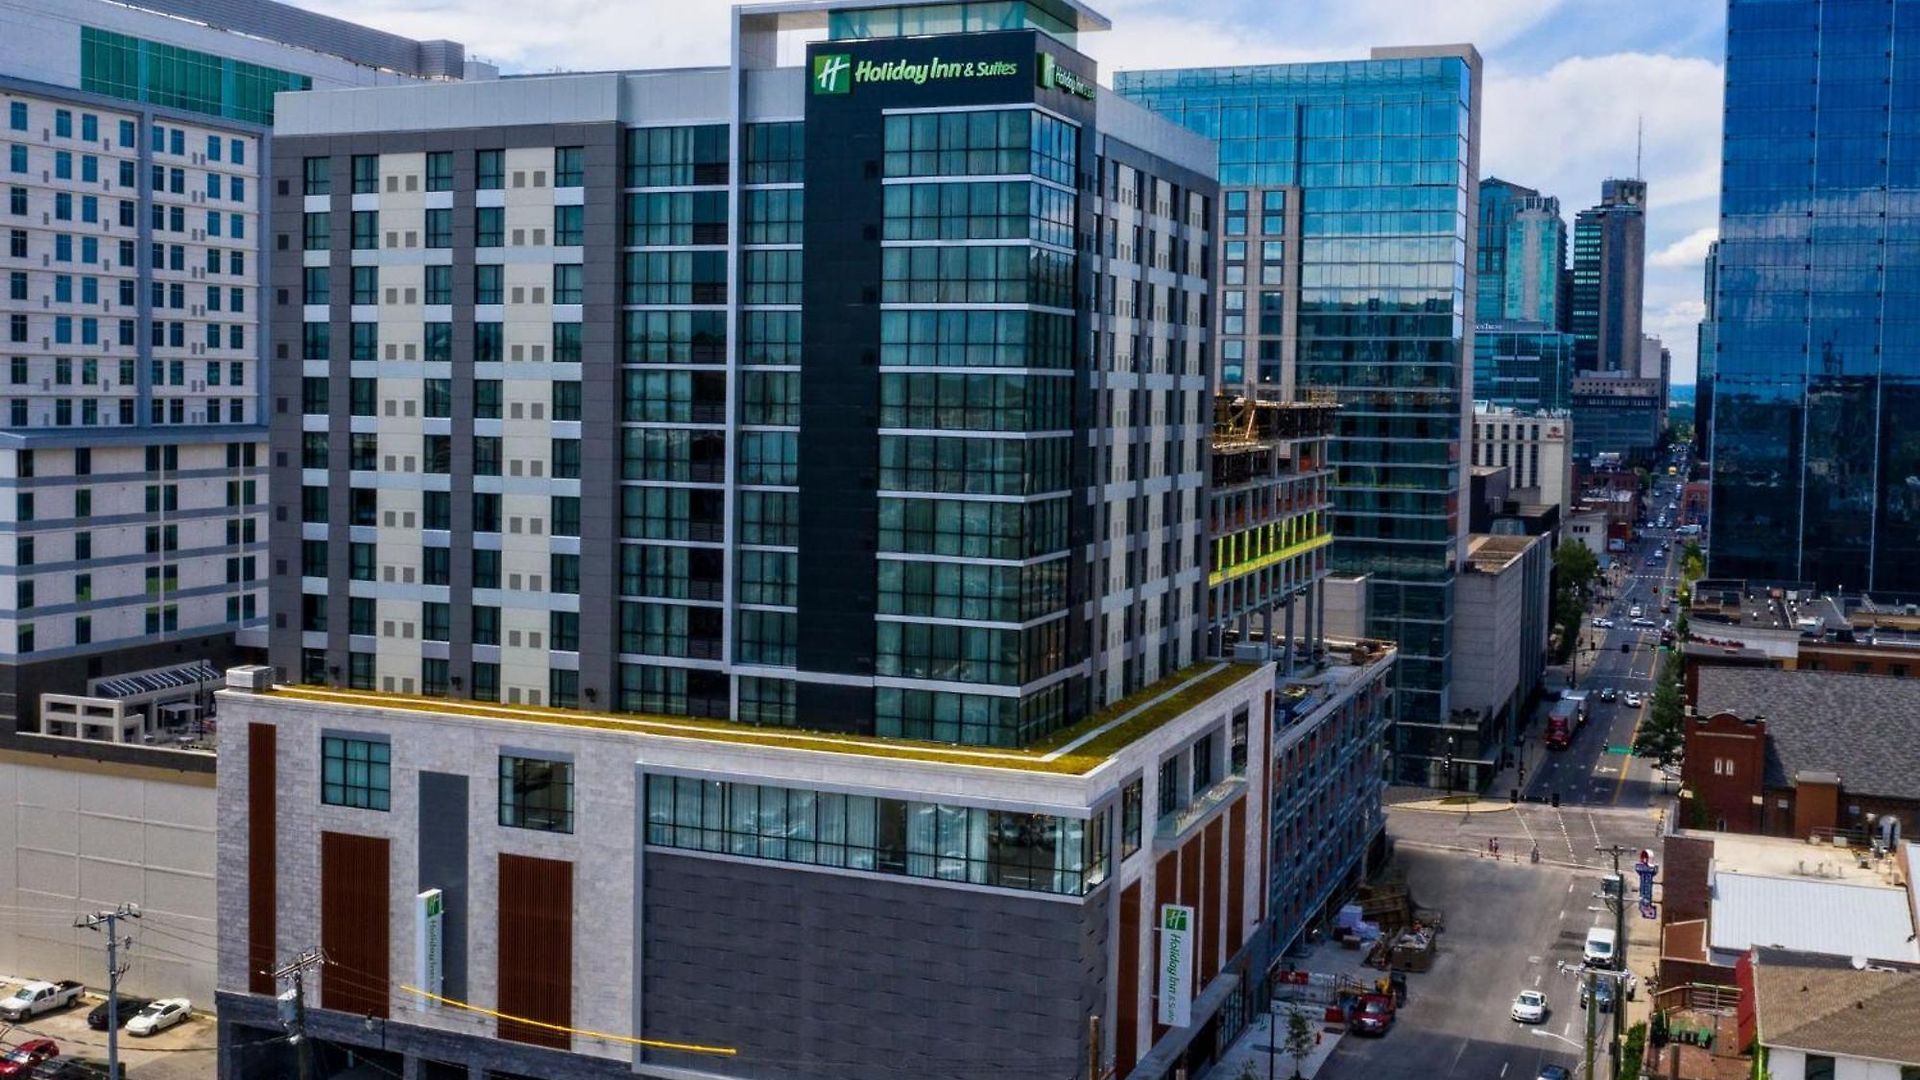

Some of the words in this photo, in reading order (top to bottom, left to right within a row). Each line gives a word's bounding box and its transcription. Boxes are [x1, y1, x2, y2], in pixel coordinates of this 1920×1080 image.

[855, 59, 929, 85] Holiday
[930, 57, 962, 79] Inn
[963, 62, 975, 77] &
[976, 61, 1018, 77] Suites
[1167, 933, 1181, 976] Holiday
[1168, 976, 1180, 993] Inn
